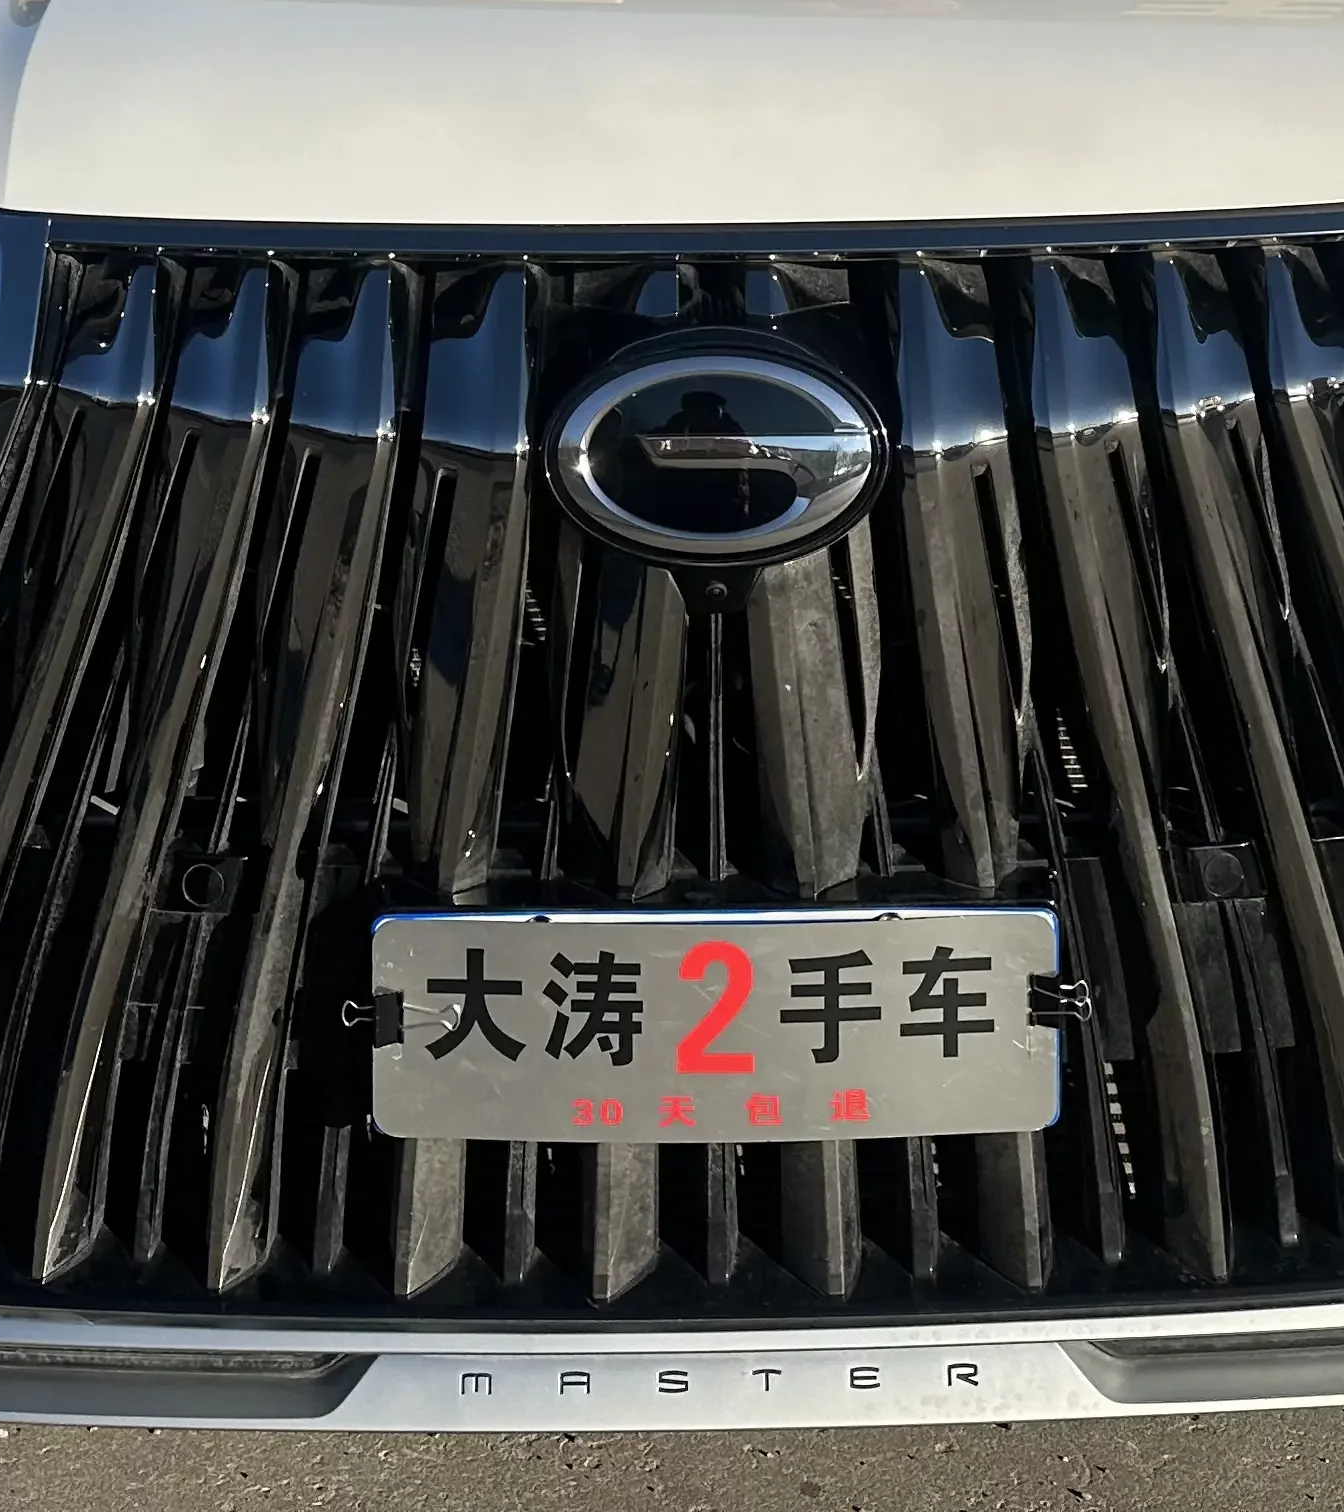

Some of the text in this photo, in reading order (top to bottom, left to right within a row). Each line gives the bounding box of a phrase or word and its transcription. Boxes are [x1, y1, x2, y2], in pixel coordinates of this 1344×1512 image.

[424, 940, 996, 1076] 大涛2手车
[459, 1362, 980, 1397] MASTER
